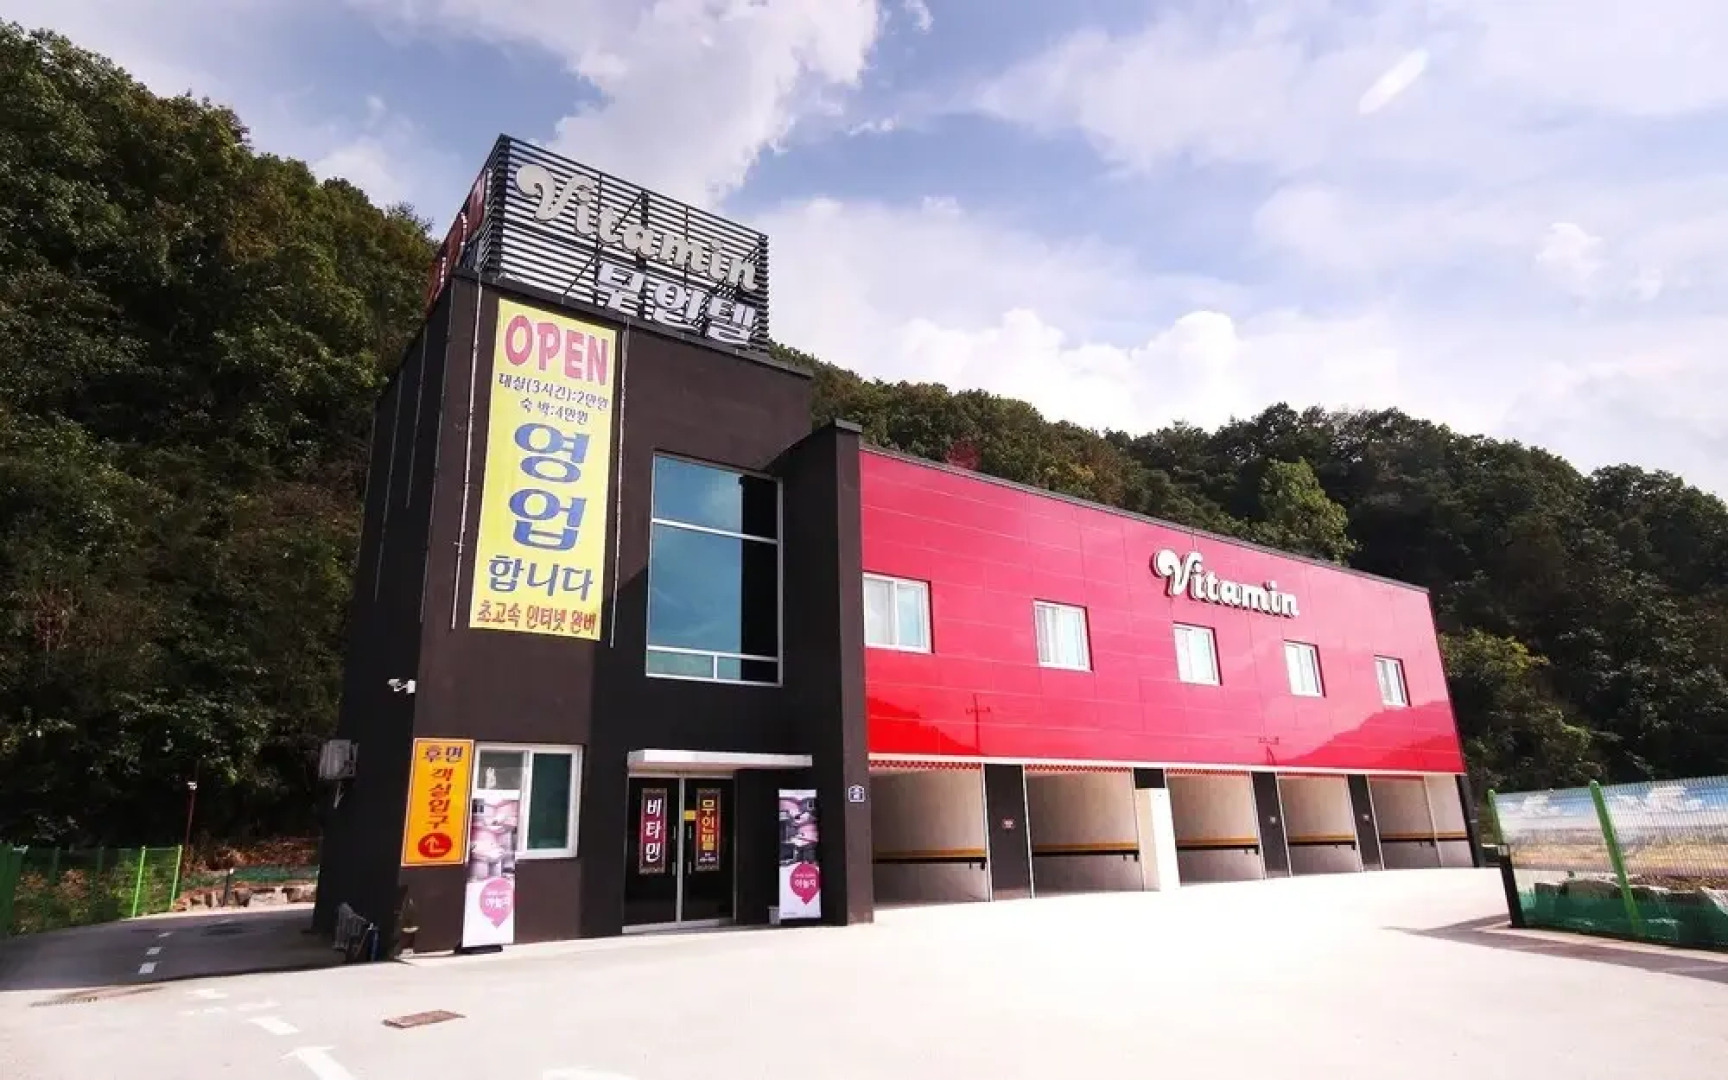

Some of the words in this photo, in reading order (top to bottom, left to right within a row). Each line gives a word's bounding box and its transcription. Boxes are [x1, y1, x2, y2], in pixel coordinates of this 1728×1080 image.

[516, 165, 758, 291] Vitamin
[598, 261, 755, 345] 무인텔
[505, 315, 609, 386] OPEN
[488, 554, 594, 602] 합니다
[1153, 549, 1300, 616] Vitamin
[476, 599, 521, 628] 초고속
[526, 604, 568, 632] 인터넷
[645, 798, 662, 863] 비타민
